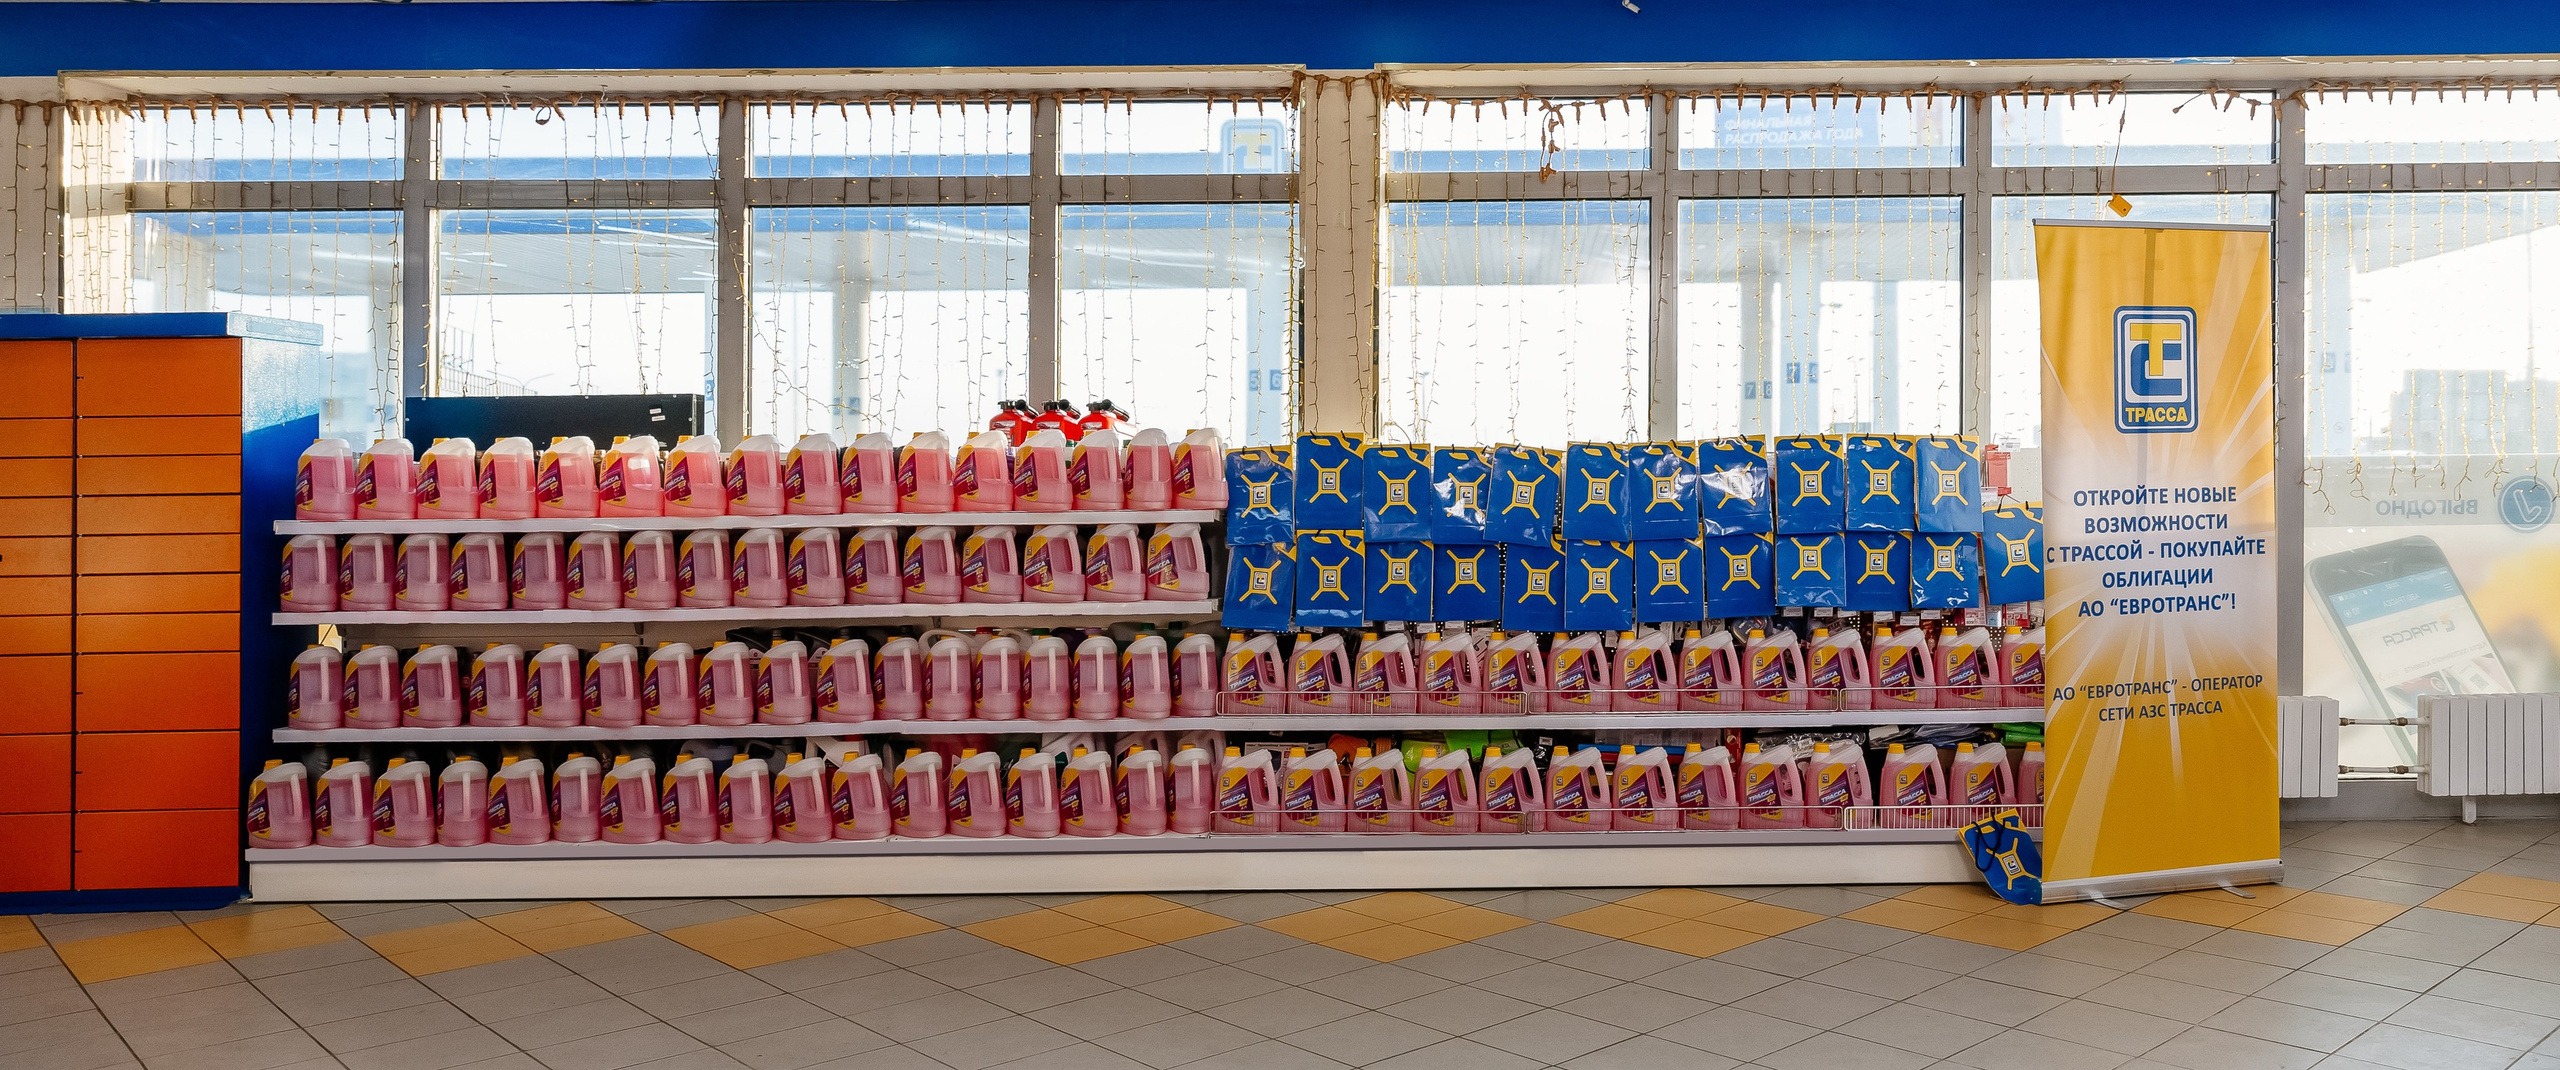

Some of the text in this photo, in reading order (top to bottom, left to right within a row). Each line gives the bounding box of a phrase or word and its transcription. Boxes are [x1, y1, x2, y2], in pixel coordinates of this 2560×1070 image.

[1724, 115, 1814, 131] ФИНАЛЬНАЯ
[1725, 126, 1864, 145] РАСПРОДАЖА ГОДА
[2125, 407, 2188, 422] ТРАССА
[2073, 484, 2236, 506] ОТКРОЙТЕ НОВЫЕ
[2085, 514, 2228, 534] ВОЗМОЖНОСТИ
[2046, 546, 2055, 563] С
[2060, 540, 2142, 563] ТРАССОЙ
[2160, 536, 2266, 559] ПОКУПАЙТЕ
[2102, 568, 2213, 589] ОБЛИГАЦИИ
[2078, 593, 2236, 617] АО “ЕВРОТРАНС”!
[2053, 686, 2075, 701] АО
[2080, 679, 2178, 699] “ЕВРОТРАНС”
[2191, 674, 2263, 692] ОПЕРАТОР
[2099, 700, 2222, 721] СЕТИ АЗС ТРАССА
